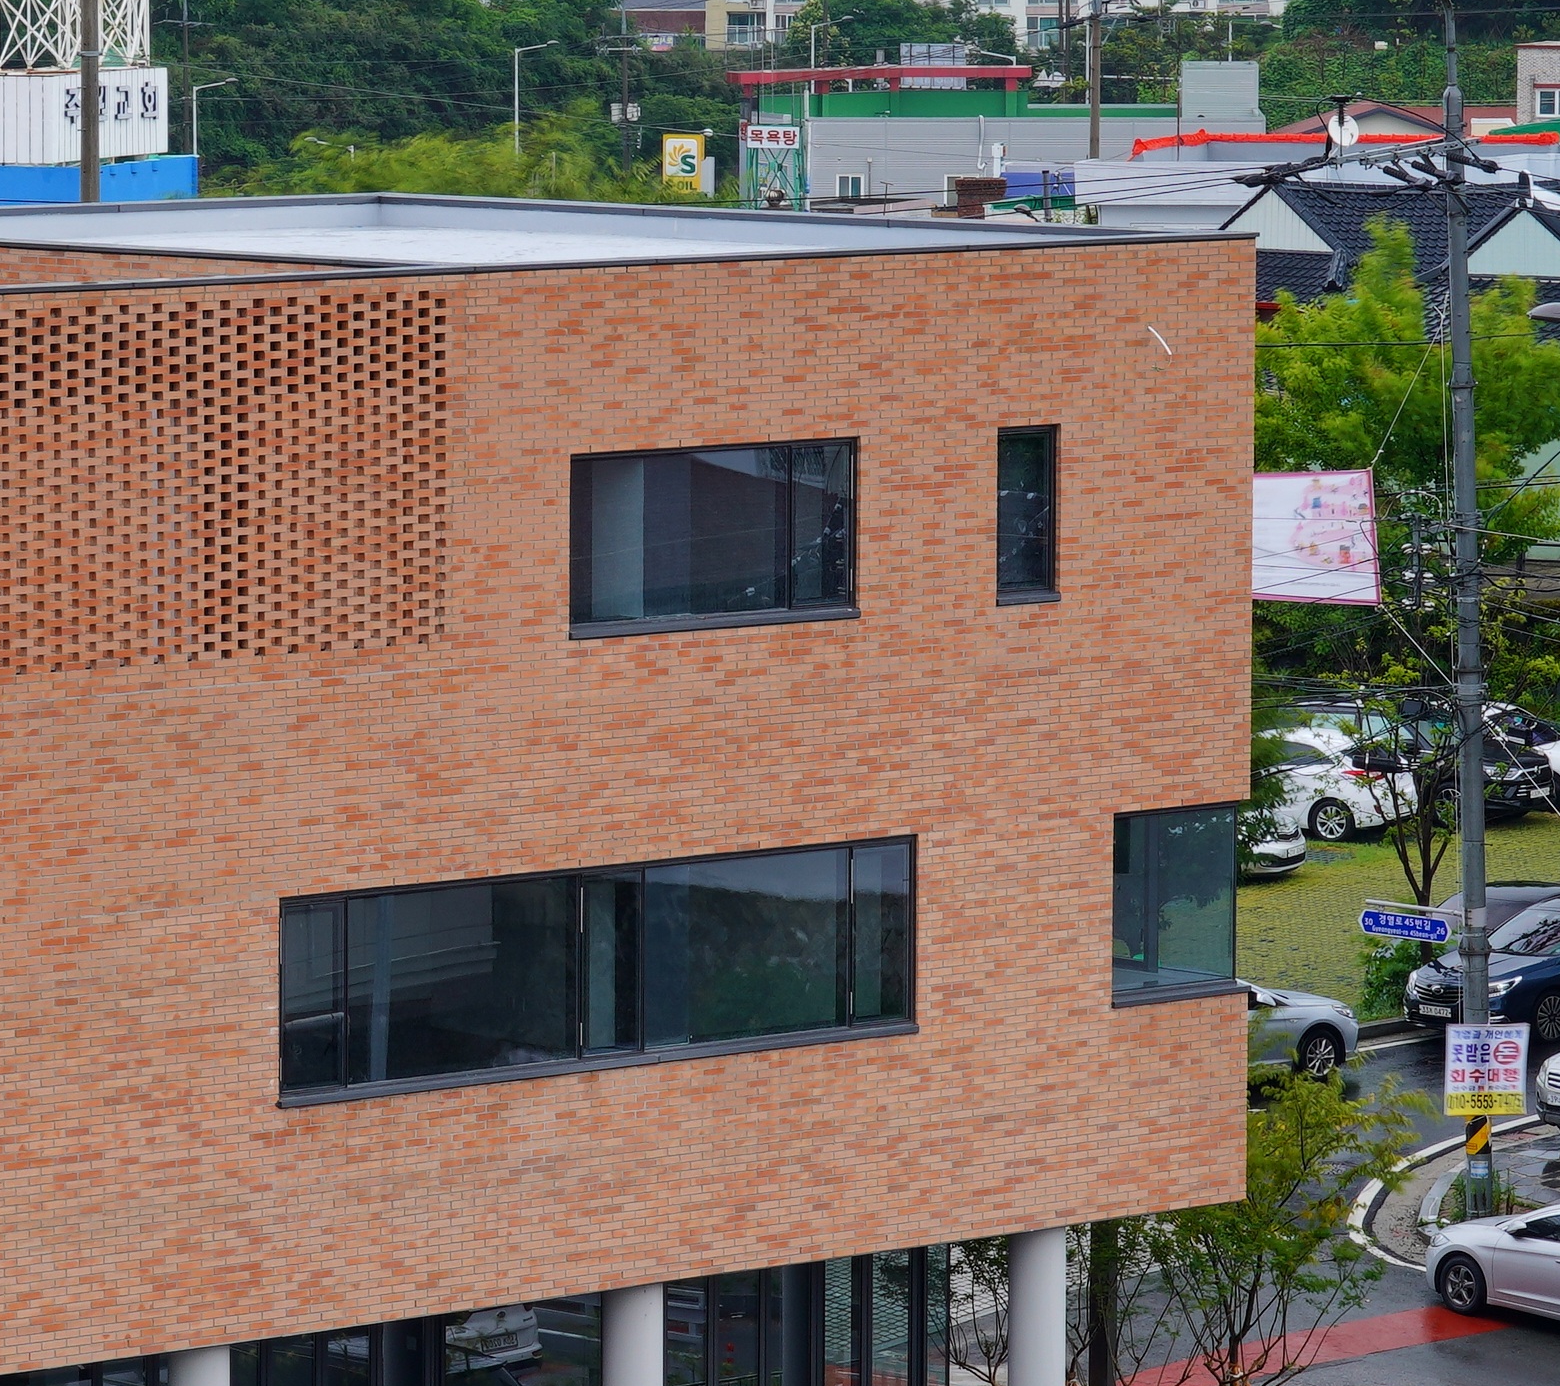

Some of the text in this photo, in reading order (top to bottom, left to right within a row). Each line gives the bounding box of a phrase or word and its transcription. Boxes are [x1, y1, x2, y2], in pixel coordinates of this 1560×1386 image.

[750, 129, 797, 146] 목욕탕
[1364, 917, 1374, 926] 30
[1436, 927, 1446, 936] 26
